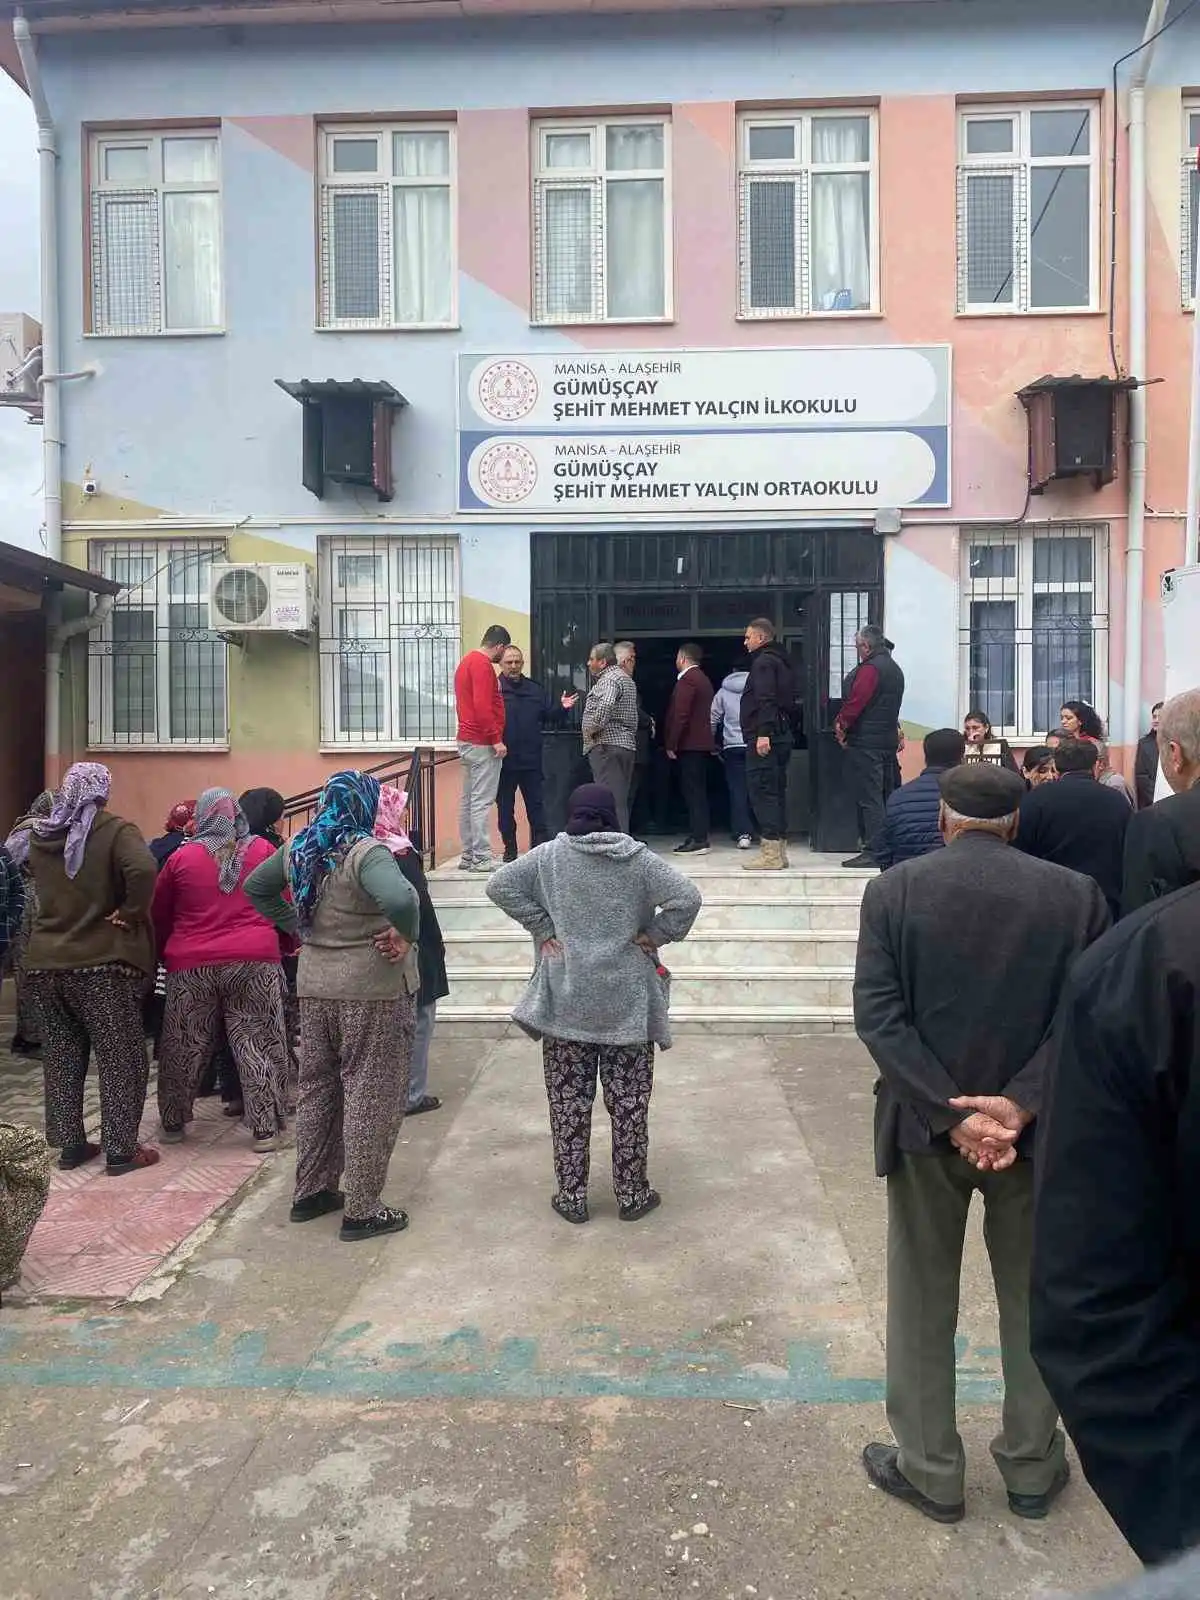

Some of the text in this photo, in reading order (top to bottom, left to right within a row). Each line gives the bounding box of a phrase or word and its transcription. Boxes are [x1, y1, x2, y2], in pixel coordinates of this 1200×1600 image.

[554, 362, 607, 375] MANİSA
[618, 360, 682, 376] ALAŞEHİR
[553, 377, 659, 400] GÜMÜŞÇAY
[553, 396, 857, 422] ŞEHİT MEHMET YALÇIN İLKOKULU
[554, 443, 607, 456] MANİSA
[618, 441, 682, 458] ALAŞEHİR
[553, 459, 659, 481] GÜMÜŞÇAY
[553, 479, 879, 503] ŞEHİT MEHMET YALÇIN ORTAOKULU
